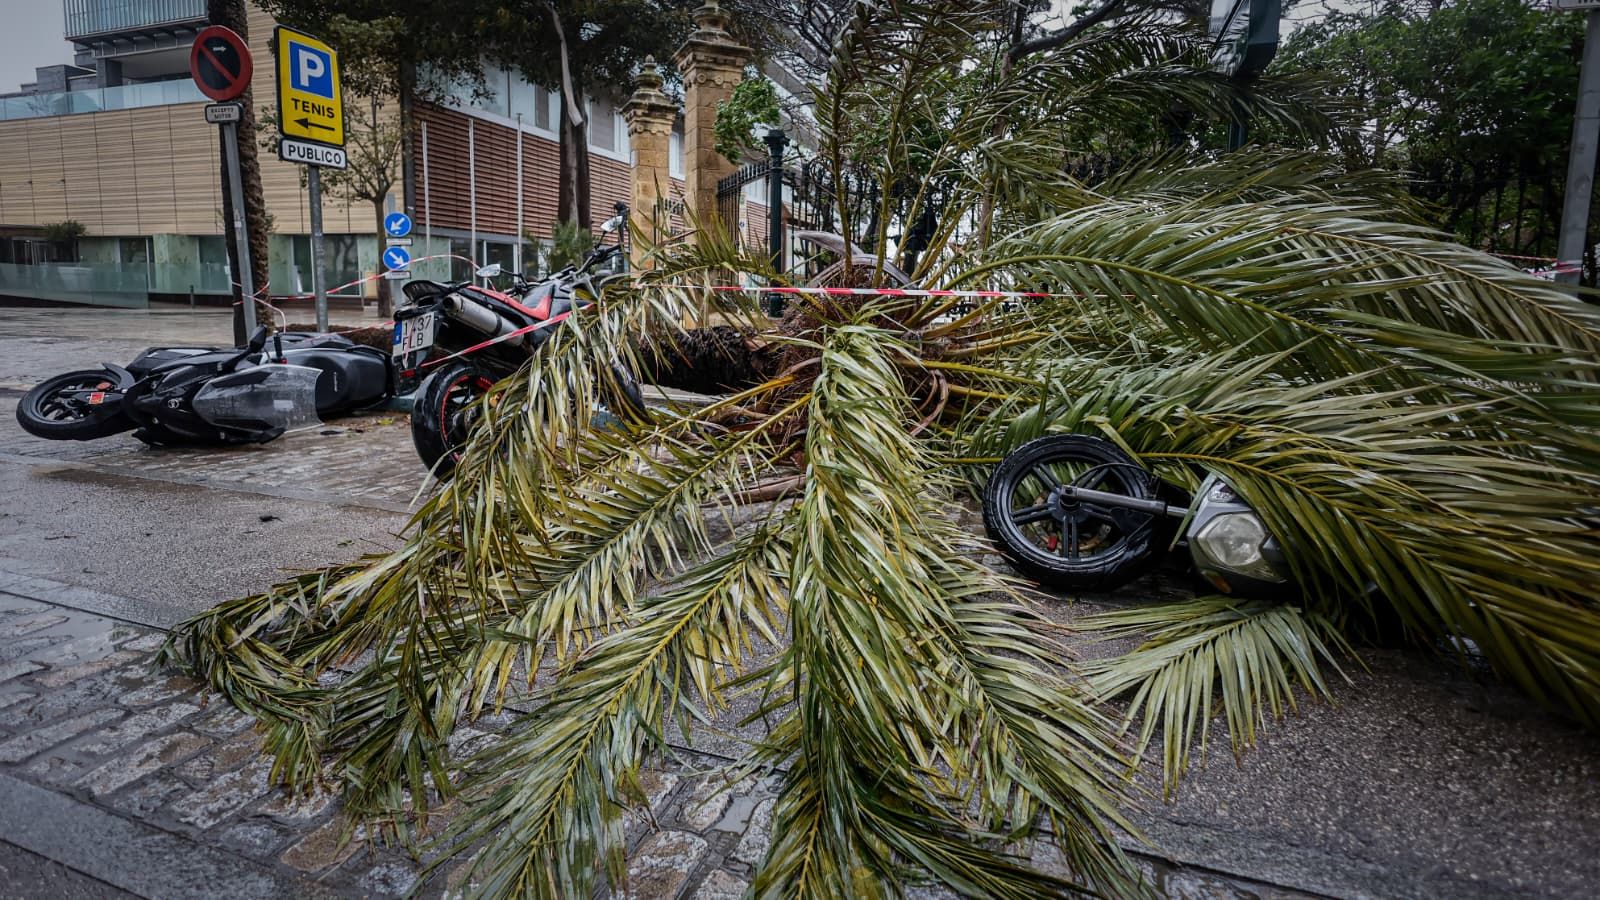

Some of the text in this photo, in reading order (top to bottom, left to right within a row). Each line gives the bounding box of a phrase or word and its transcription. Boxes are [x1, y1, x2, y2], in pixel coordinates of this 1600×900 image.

[299, 48, 325, 87] P
[291, 97, 335, 119] TENIS
[288, 144, 342, 165] PUBLICO
